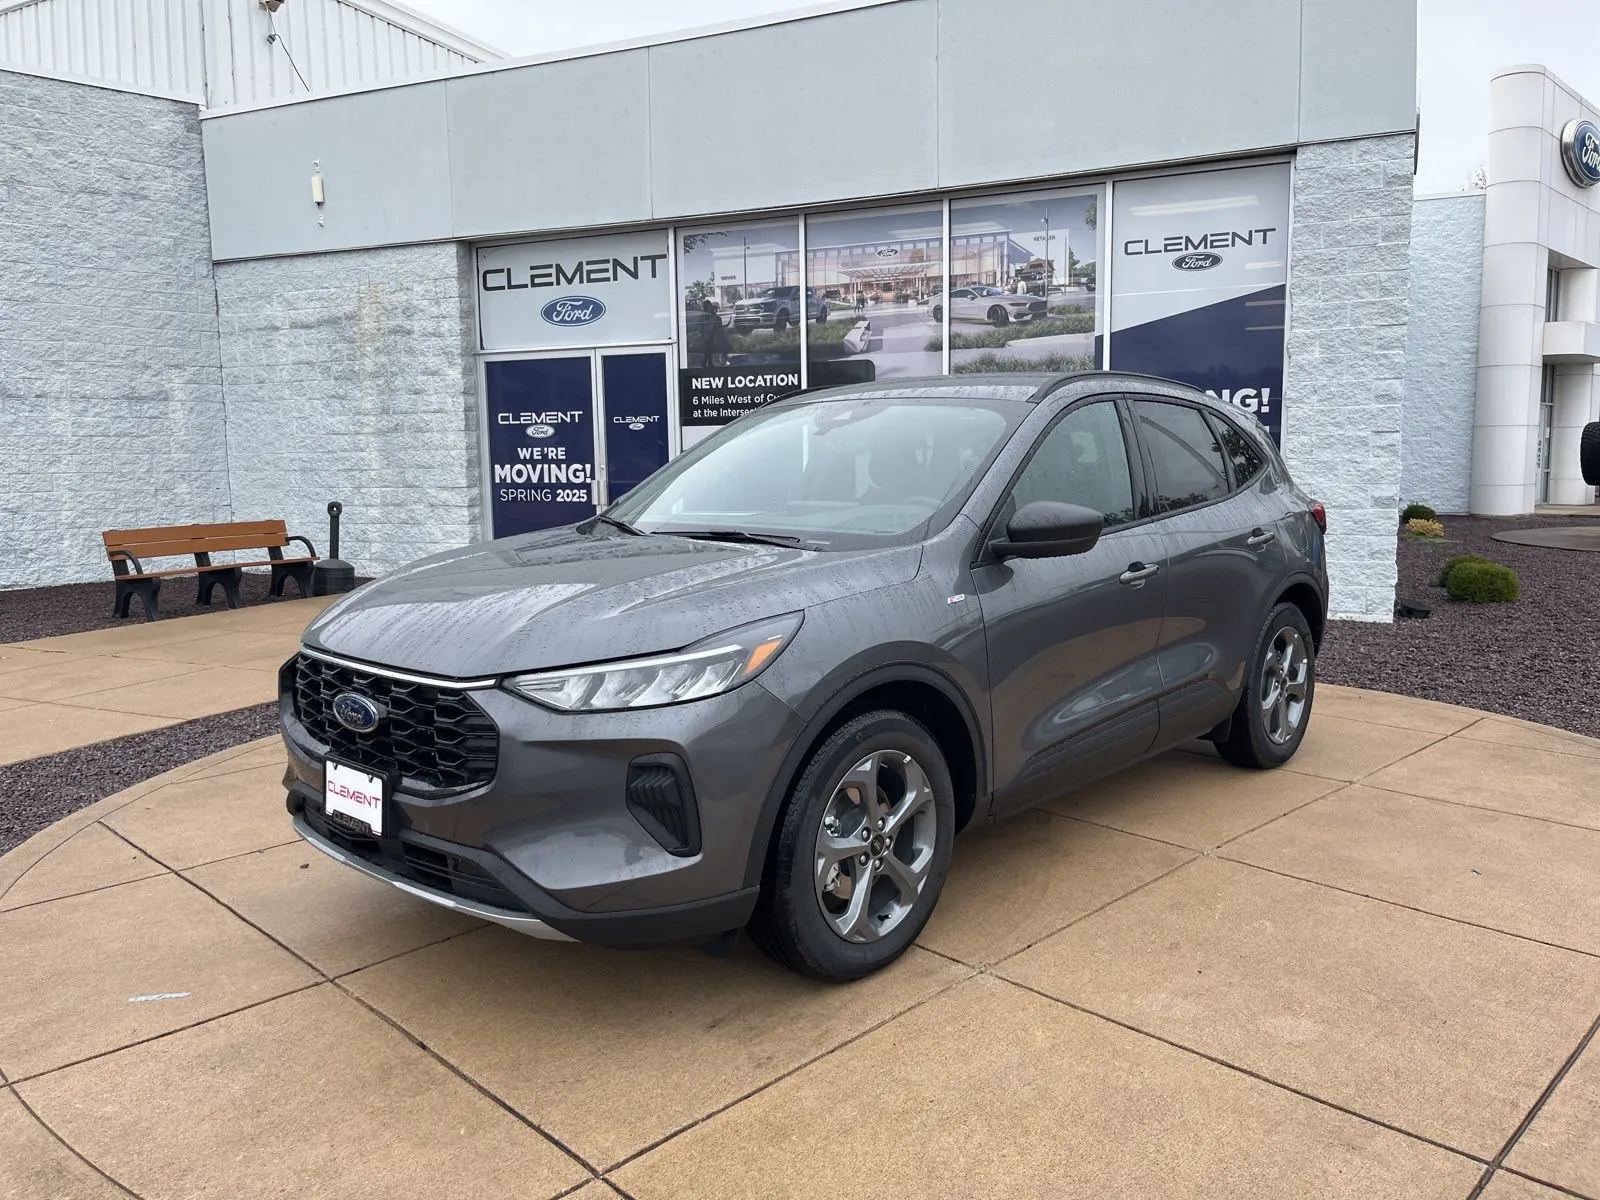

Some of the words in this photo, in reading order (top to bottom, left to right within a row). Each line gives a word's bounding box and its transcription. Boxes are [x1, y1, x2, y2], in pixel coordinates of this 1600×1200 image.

[1124, 228, 1276, 256] CLEMENT
[482, 254, 667, 292] CLEMENT
[692, 377, 724, 390] NEW
[728, 374, 798, 388] LOCATION
[692, 396, 699, 406] 6
[701, 395, 725, 405] Miles
[727, 394, 752, 404] West
[754, 394, 764, 403] of
[497, 411, 583, 425] CLEMENT
[613, 415, 660, 424] CLEMENT
[692, 409, 702, 418] at
[704, 408, 718, 417] the
[517, 447, 566, 460] WE'RE
[494, 463, 592, 484] MOVING!
[500, 488, 552, 502] SPRING
[556, 489, 588, 502] 2025
[327, 780, 381, 809] CLEMENT
